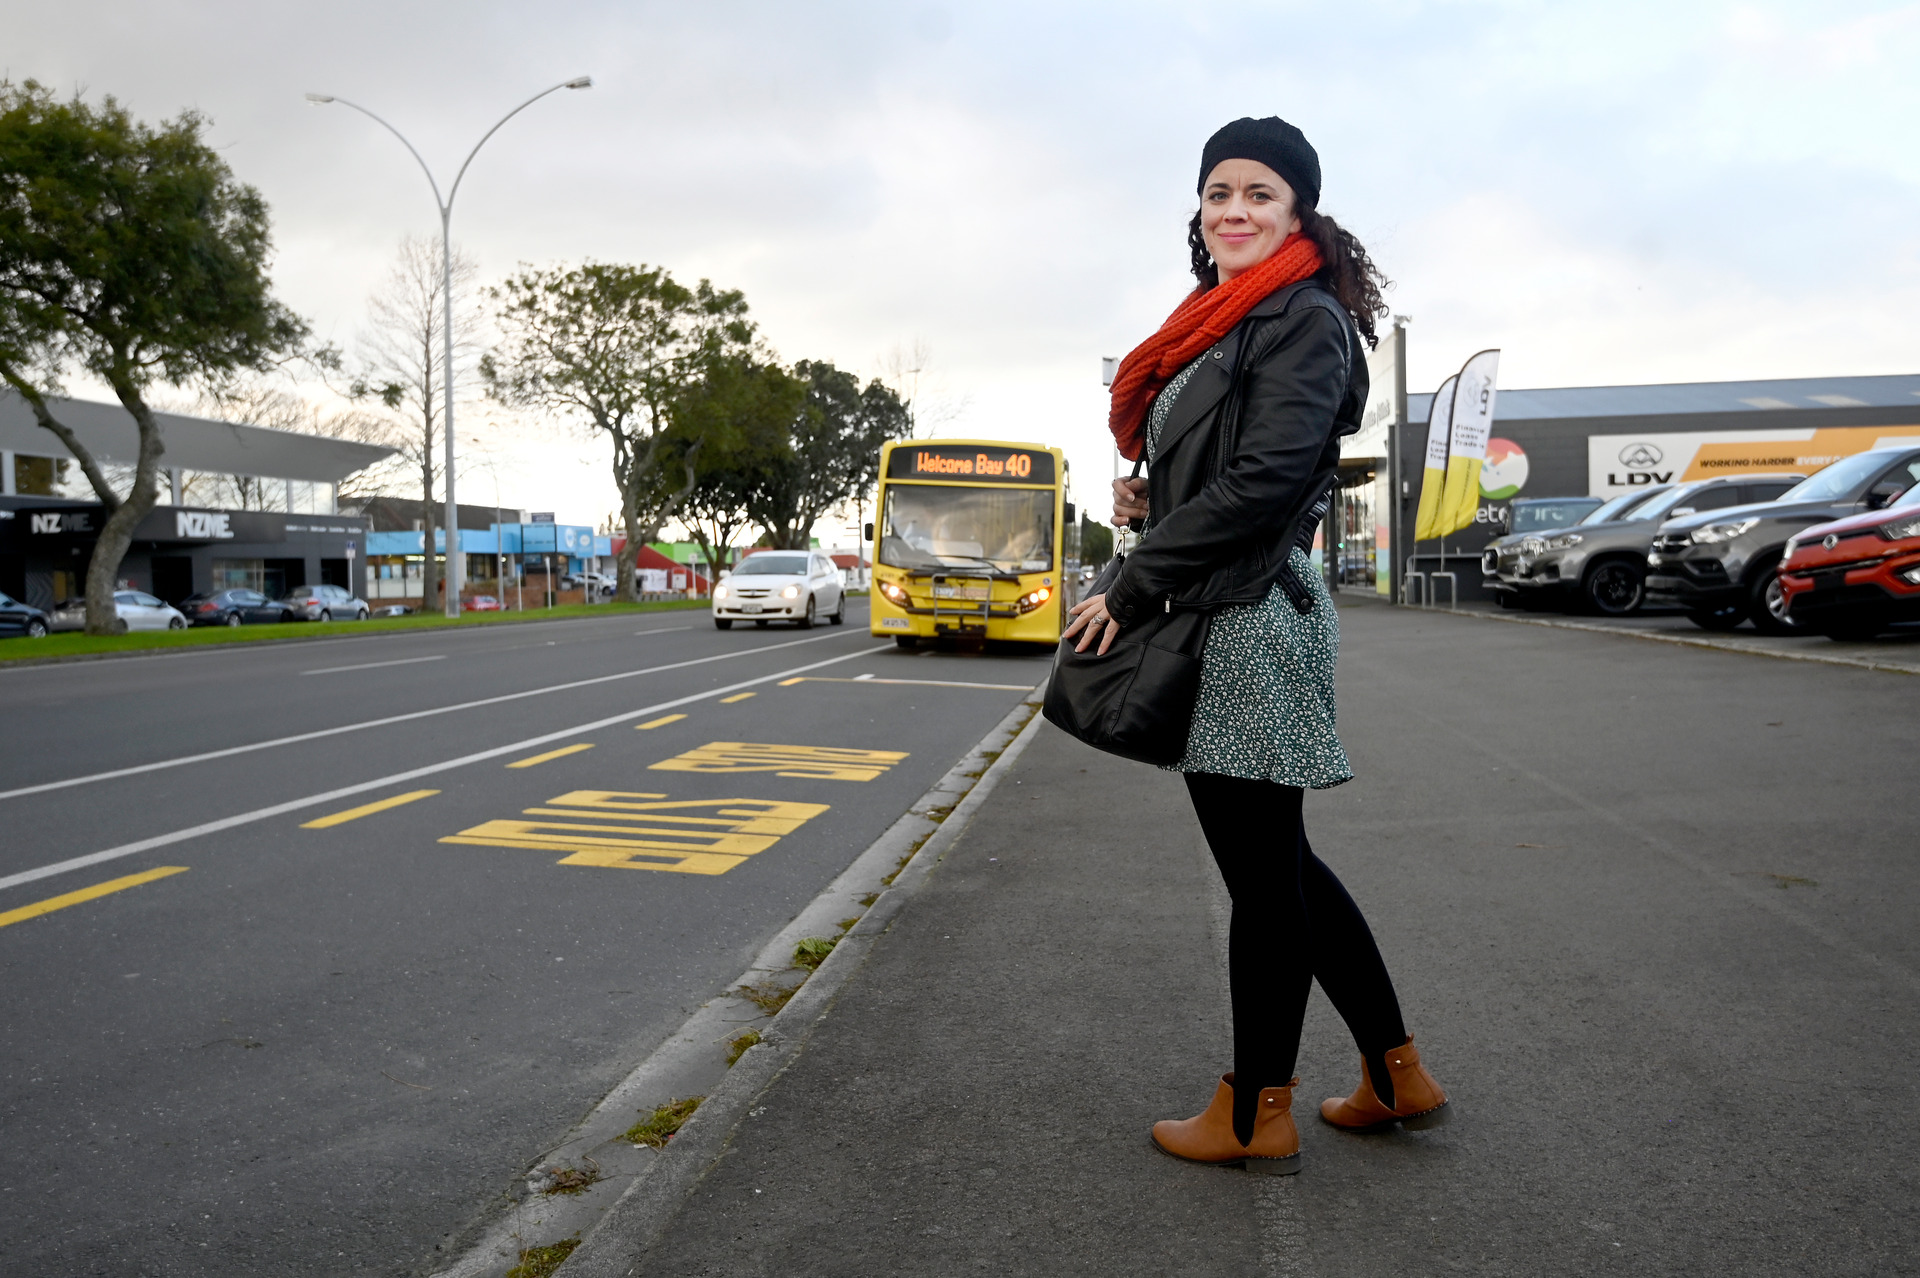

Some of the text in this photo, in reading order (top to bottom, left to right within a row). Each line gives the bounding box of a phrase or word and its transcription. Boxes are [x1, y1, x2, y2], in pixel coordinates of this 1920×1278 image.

[1480, 376, 1491, 415] LDV
[917, 452, 1031, 477] Welcome Bay 40
[1700, 458, 1750, 468] WORKING
[1751, 457, 1795, 467] HARDER
[1608, 472, 1673, 486] LDV
[437, 742, 911, 875] BUS STOP
